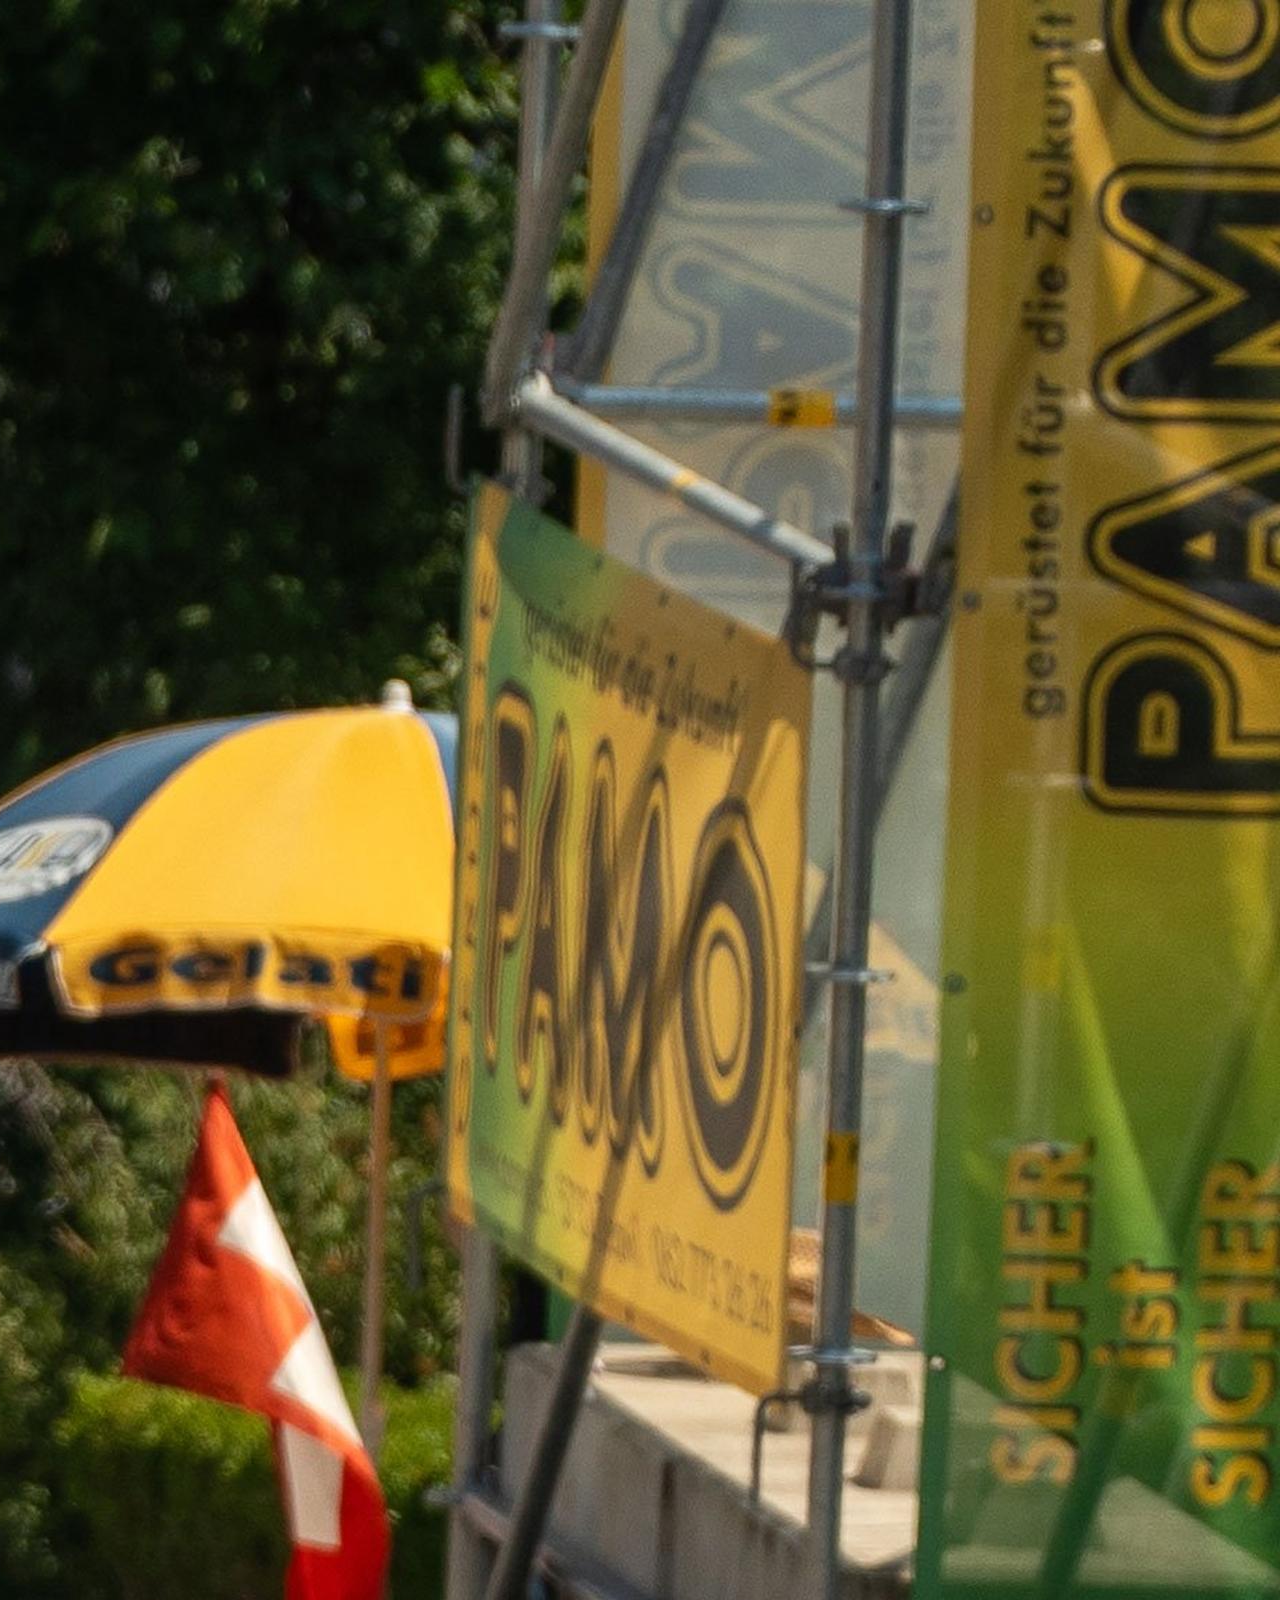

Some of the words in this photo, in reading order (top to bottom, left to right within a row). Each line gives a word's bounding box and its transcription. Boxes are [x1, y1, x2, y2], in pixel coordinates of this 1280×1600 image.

[1024, 12, 1076, 240] Zukunft
[1017, 376, 1066, 458] für
[1021, 263, 1069, 353] die
[1013, 480, 1067, 720] gerüstet
[89, 940, 423, 1000] Gelati
[481, 680, 780, 1213] PAMO
[989, 1138, 1096, 1489] SICHER
[1091, 1258, 1180, 1371] ist
[1191, 1158, 1280, 1508] SICHER
